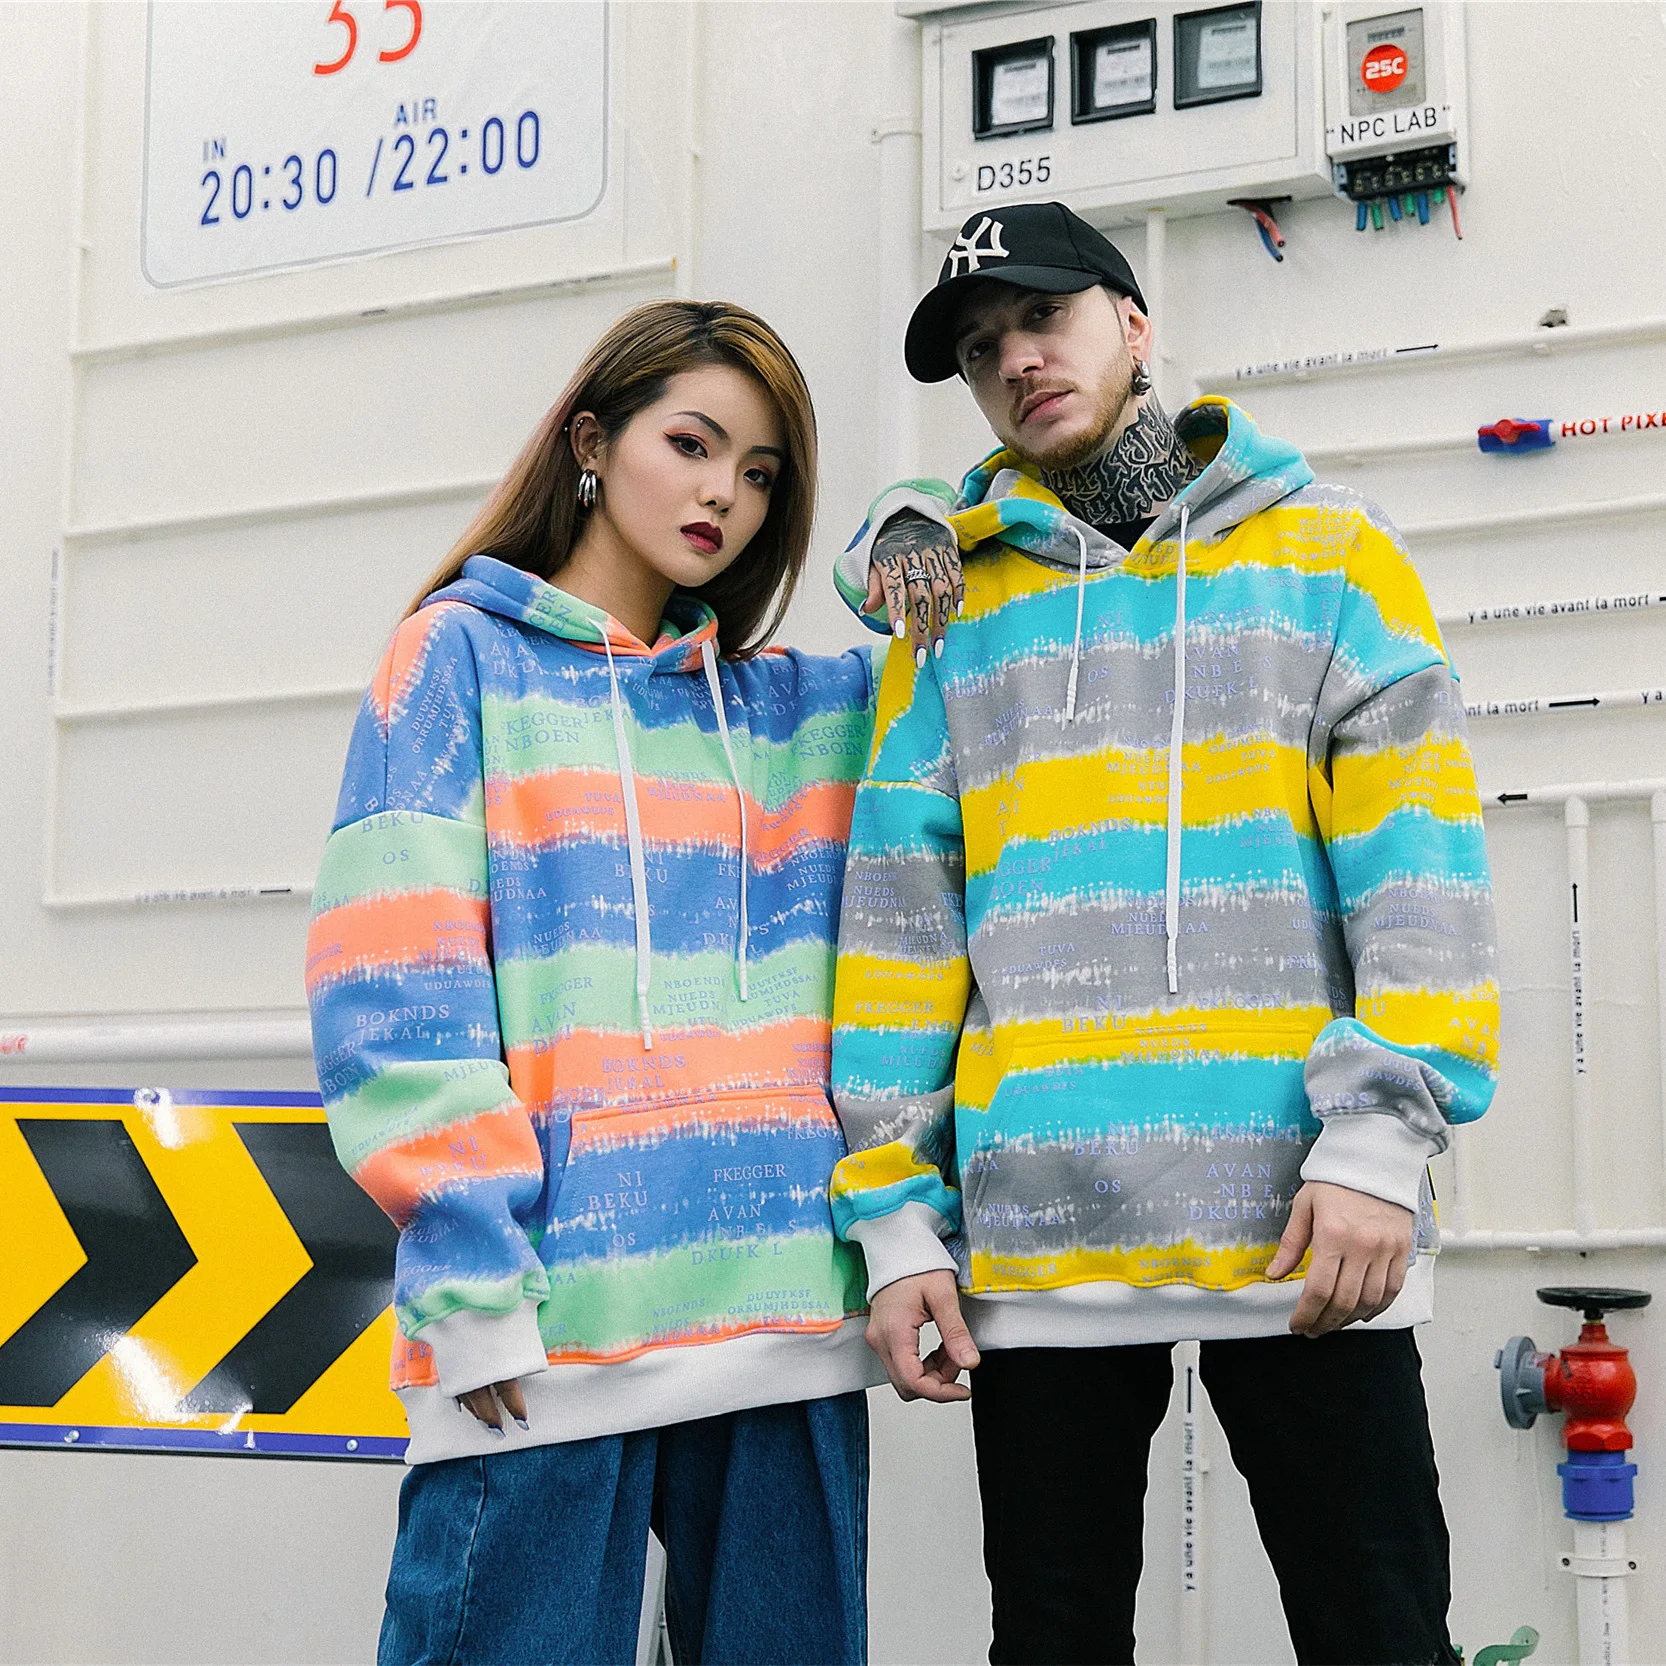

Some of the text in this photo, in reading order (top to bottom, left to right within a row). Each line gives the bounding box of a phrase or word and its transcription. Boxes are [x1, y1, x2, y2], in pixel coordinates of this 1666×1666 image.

[1365, 56, 1405, 80] 25C
[394, 97, 438, 126] AIR
[202, 138, 228, 162] IN
[977, 156, 1051, 192] D355
[200, 148, 338, 227] 20:30
[1561, 416, 1612, 438] HOT
[1467, 609, 1475, 624] y
[1480, 609, 1489, 621] a
[1493, 606, 1520, 619] une
[1525, 603, 1546, 616] vie
[1551, 598, 1590, 613] avant
[1595, 596, 1609, 611] la
[1087, 665, 1109, 683] OS
[1654, 690, 1663, 701] a
[1486, 702, 1500, 716] la
[504, 728, 581, 753] NBOEN
[1240, 749, 1276, 763] TUVA
[361, 811, 424, 834] BEKU
[1049, 817, 1132, 843] BOKNDS
[382, 849, 410, 866] OS
[853, 885, 896, 897] NUEDS
[1388, 903, 1438, 917] NUEDS
[532, 920, 571, 944] NUEDS
[667, 988, 717, 1004] NUEDS
[763, 990, 801, 1007] TUVA
[1096, 994, 1123, 1012] NI
[355, 1003, 451, 1030] BOKNDS
[854, 1000, 935, 1015] FKEGGER
[1062, 1013, 1127, 1033] BEKU
[357, 1025, 425, 1047] JEKAL
[1138, 1036, 1190, 1049] NUEDS
[602, 1053, 687, 1073] BOKNDS
[1074, 1138, 1139, 1156] BEKU
[616, 1170, 644, 1188] NI
[713, 1163, 788, 1183] FKEGGER
[1206, 1162, 1273, 1179] AVAN
[1094, 1179, 1122, 1194] OS
[588, 1189, 649, 1212] BEKU
[987, 1202, 1030, 1215] NUEDS
[707, 1202, 763, 1222] AVAN
[612, 1231, 637, 1249] OS
[1138, 1256, 1212, 1269] NBOENDS
